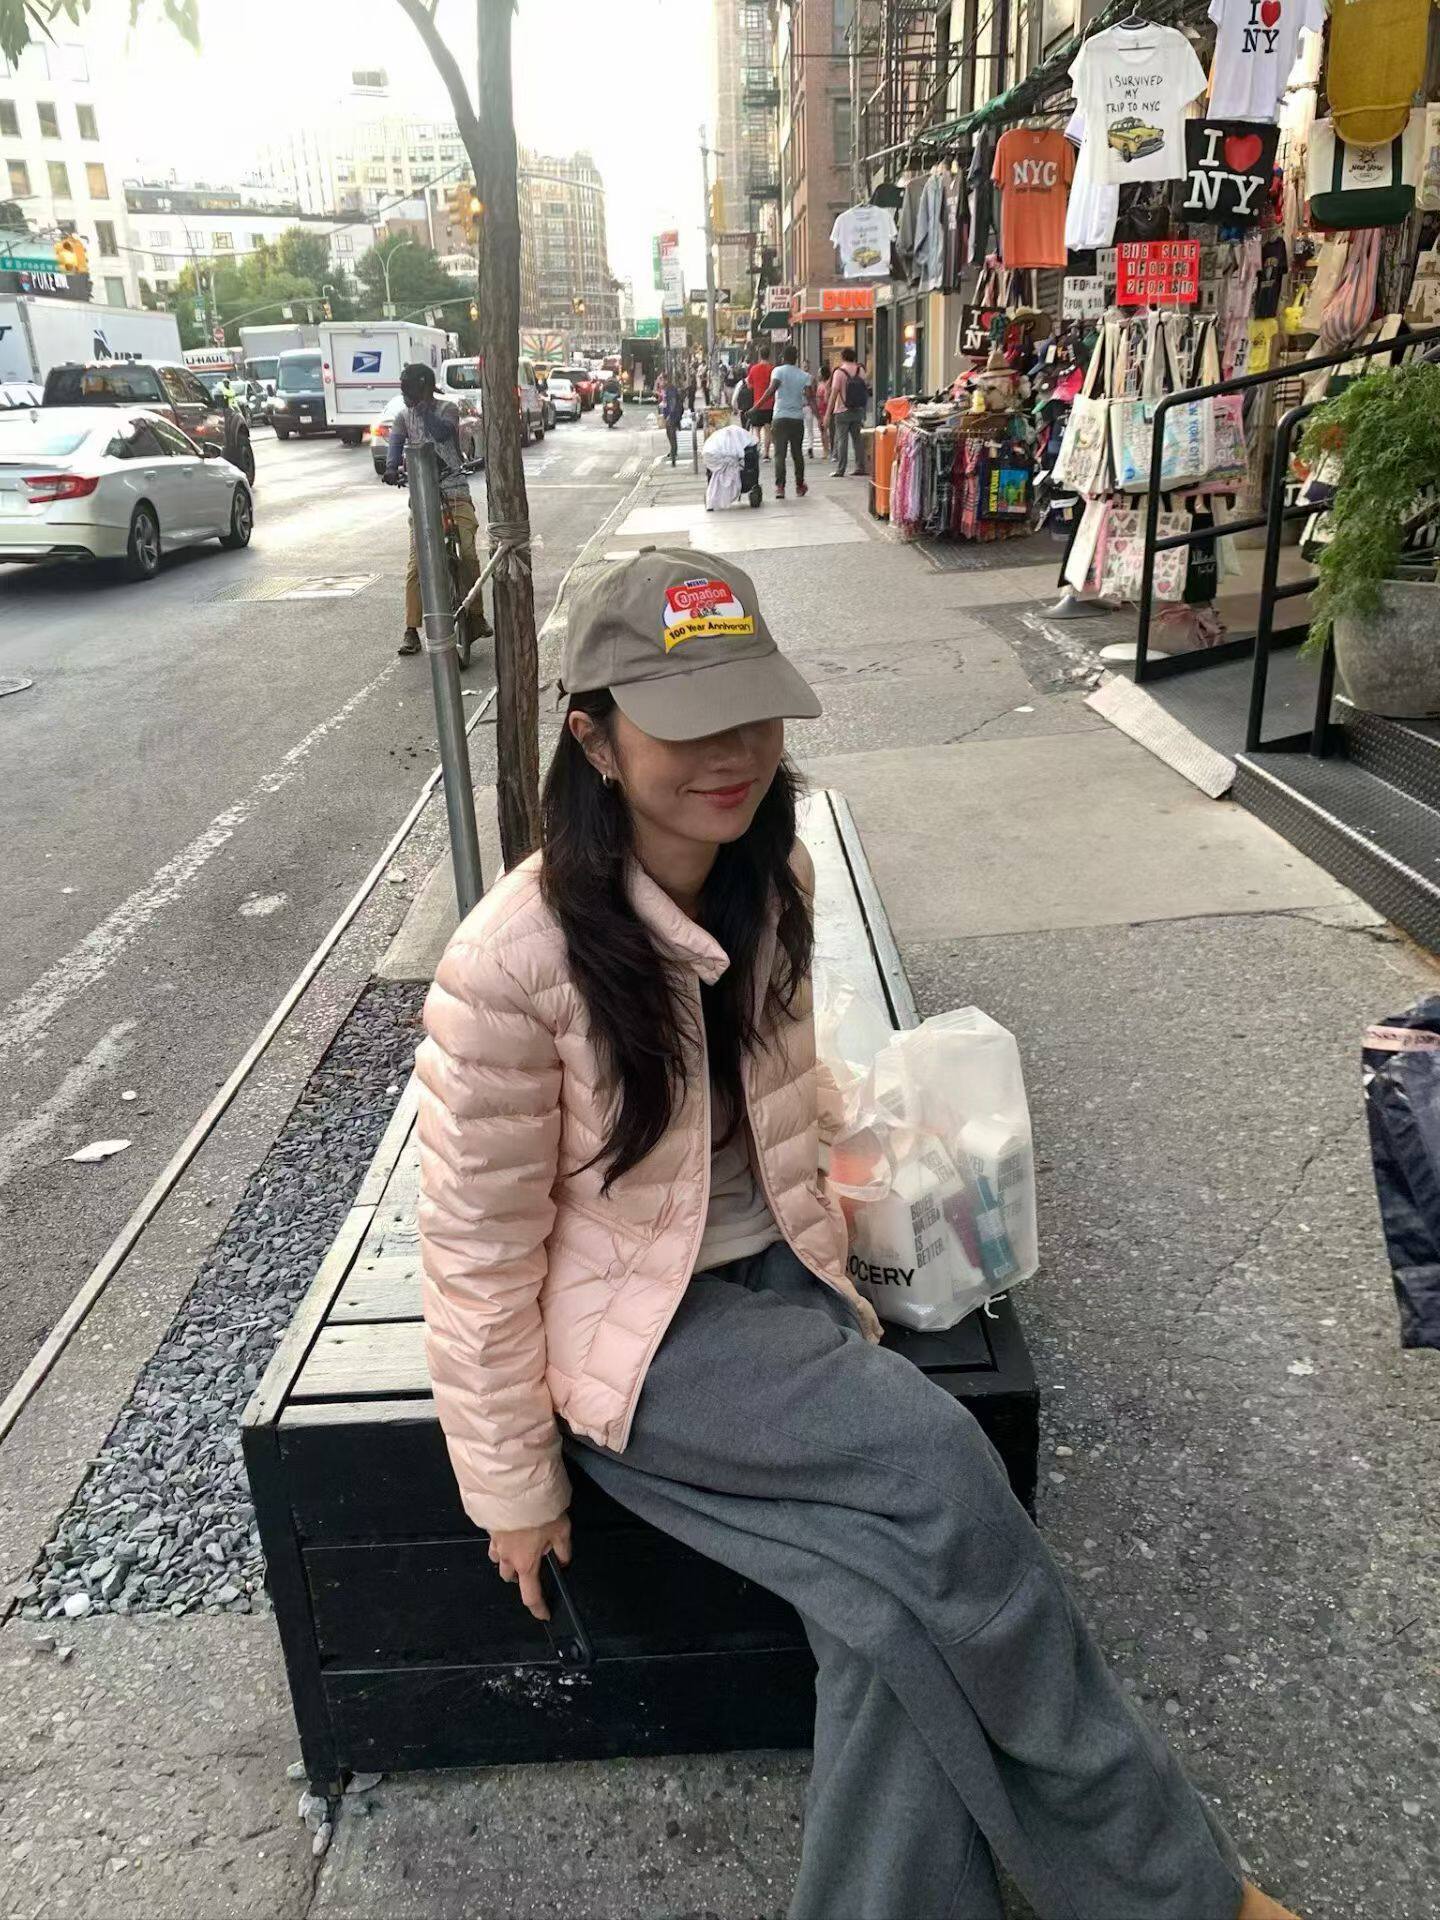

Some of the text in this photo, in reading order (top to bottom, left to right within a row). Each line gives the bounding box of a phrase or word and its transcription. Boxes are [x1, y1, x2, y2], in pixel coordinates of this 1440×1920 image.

[1242, 29, 1279, 54] NY
[1109, 75, 1163, 88] I SURVIVED
[1125, 88, 1139, 99] MY
[1106, 101, 1160, 113] TRIP TO NYC
[1199, 129, 1223, 166] I
[1012, 158, 1058, 187] NYC
[1123, 244, 1195, 257] BIG SALE
[1139, 261, 1166, 275] FOR
[1127, 280, 1134, 293] 2
[1138, 280, 1164, 293] FOR
[969, 309, 981, 329] I
[963, 330, 990, 350] N
[670, 628, 686, 640] 100
[686, 624, 705, 632] Year
[915, 1235, 924, 1253] IS
[846, 1255, 915, 1287] OCERY
